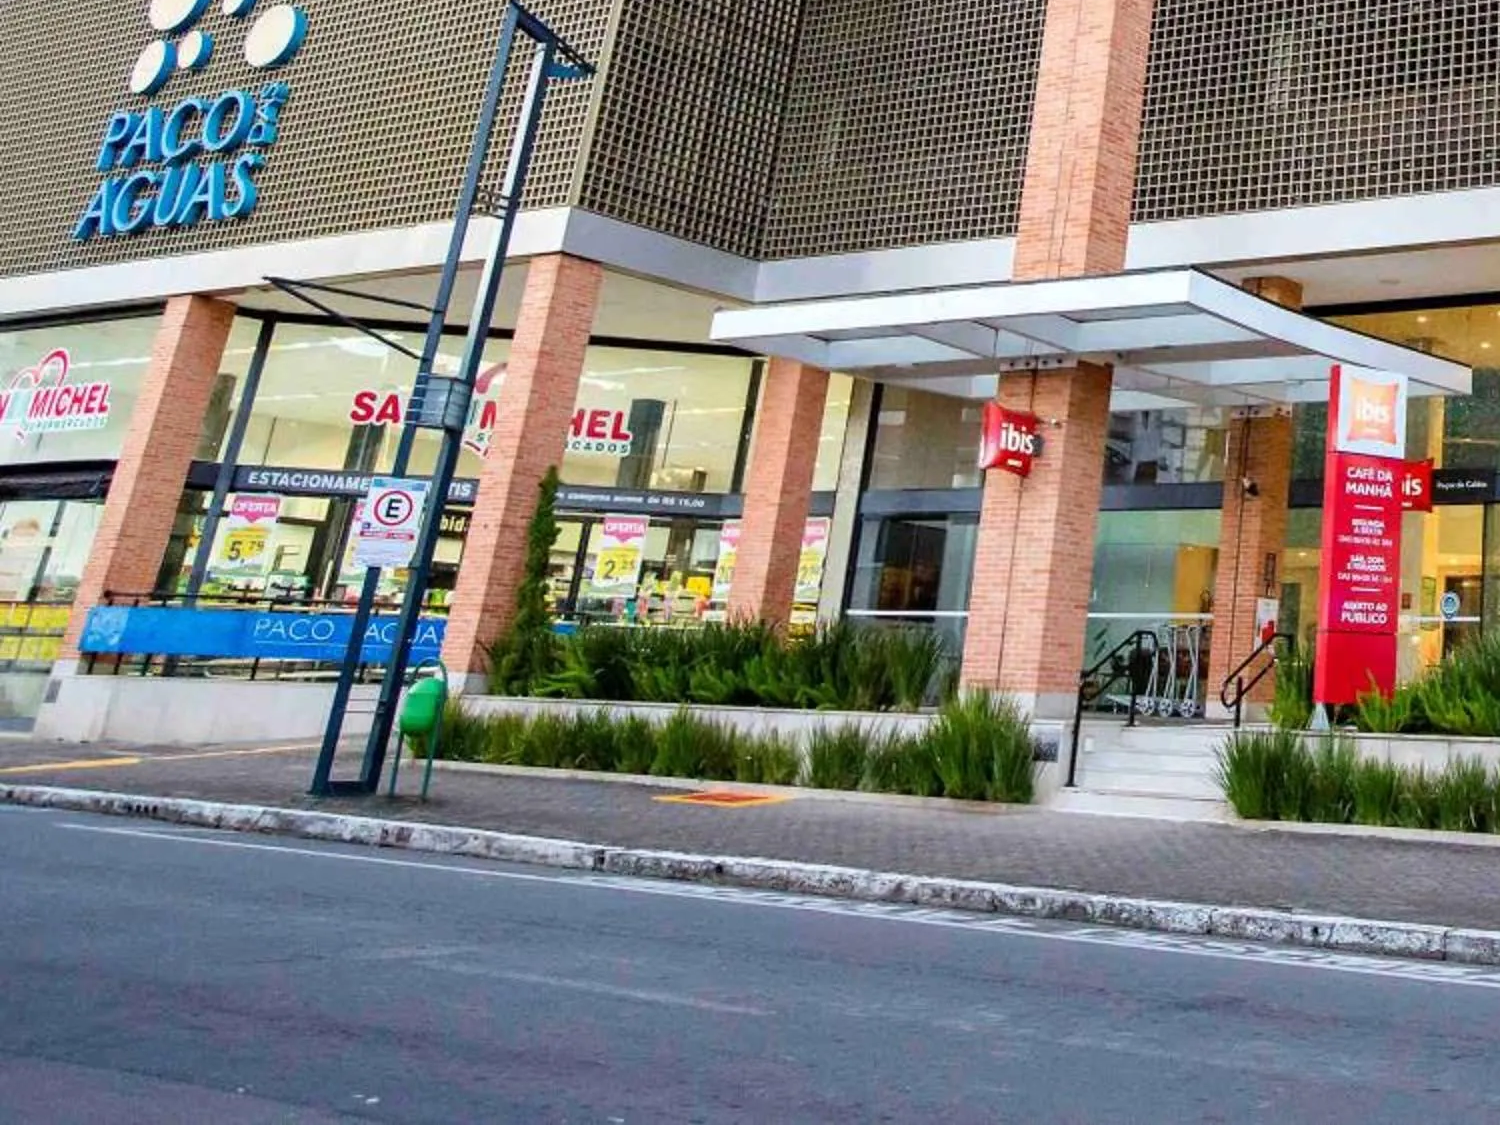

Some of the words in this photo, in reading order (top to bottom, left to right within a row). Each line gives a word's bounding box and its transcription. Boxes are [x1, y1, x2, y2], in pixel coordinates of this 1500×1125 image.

[28, 383, 109, 419] MICHEL
[350, 391, 401, 424] SA
[1355, 397, 1390, 424] ibis
[1000, 422, 1034, 455] ibis
[248, 471, 369, 491] ESTACIONAME
[1377, 470, 1393, 482] DA
[1345, 481, 1393, 498] MANHÃ
[385, 497, 403, 519] E
